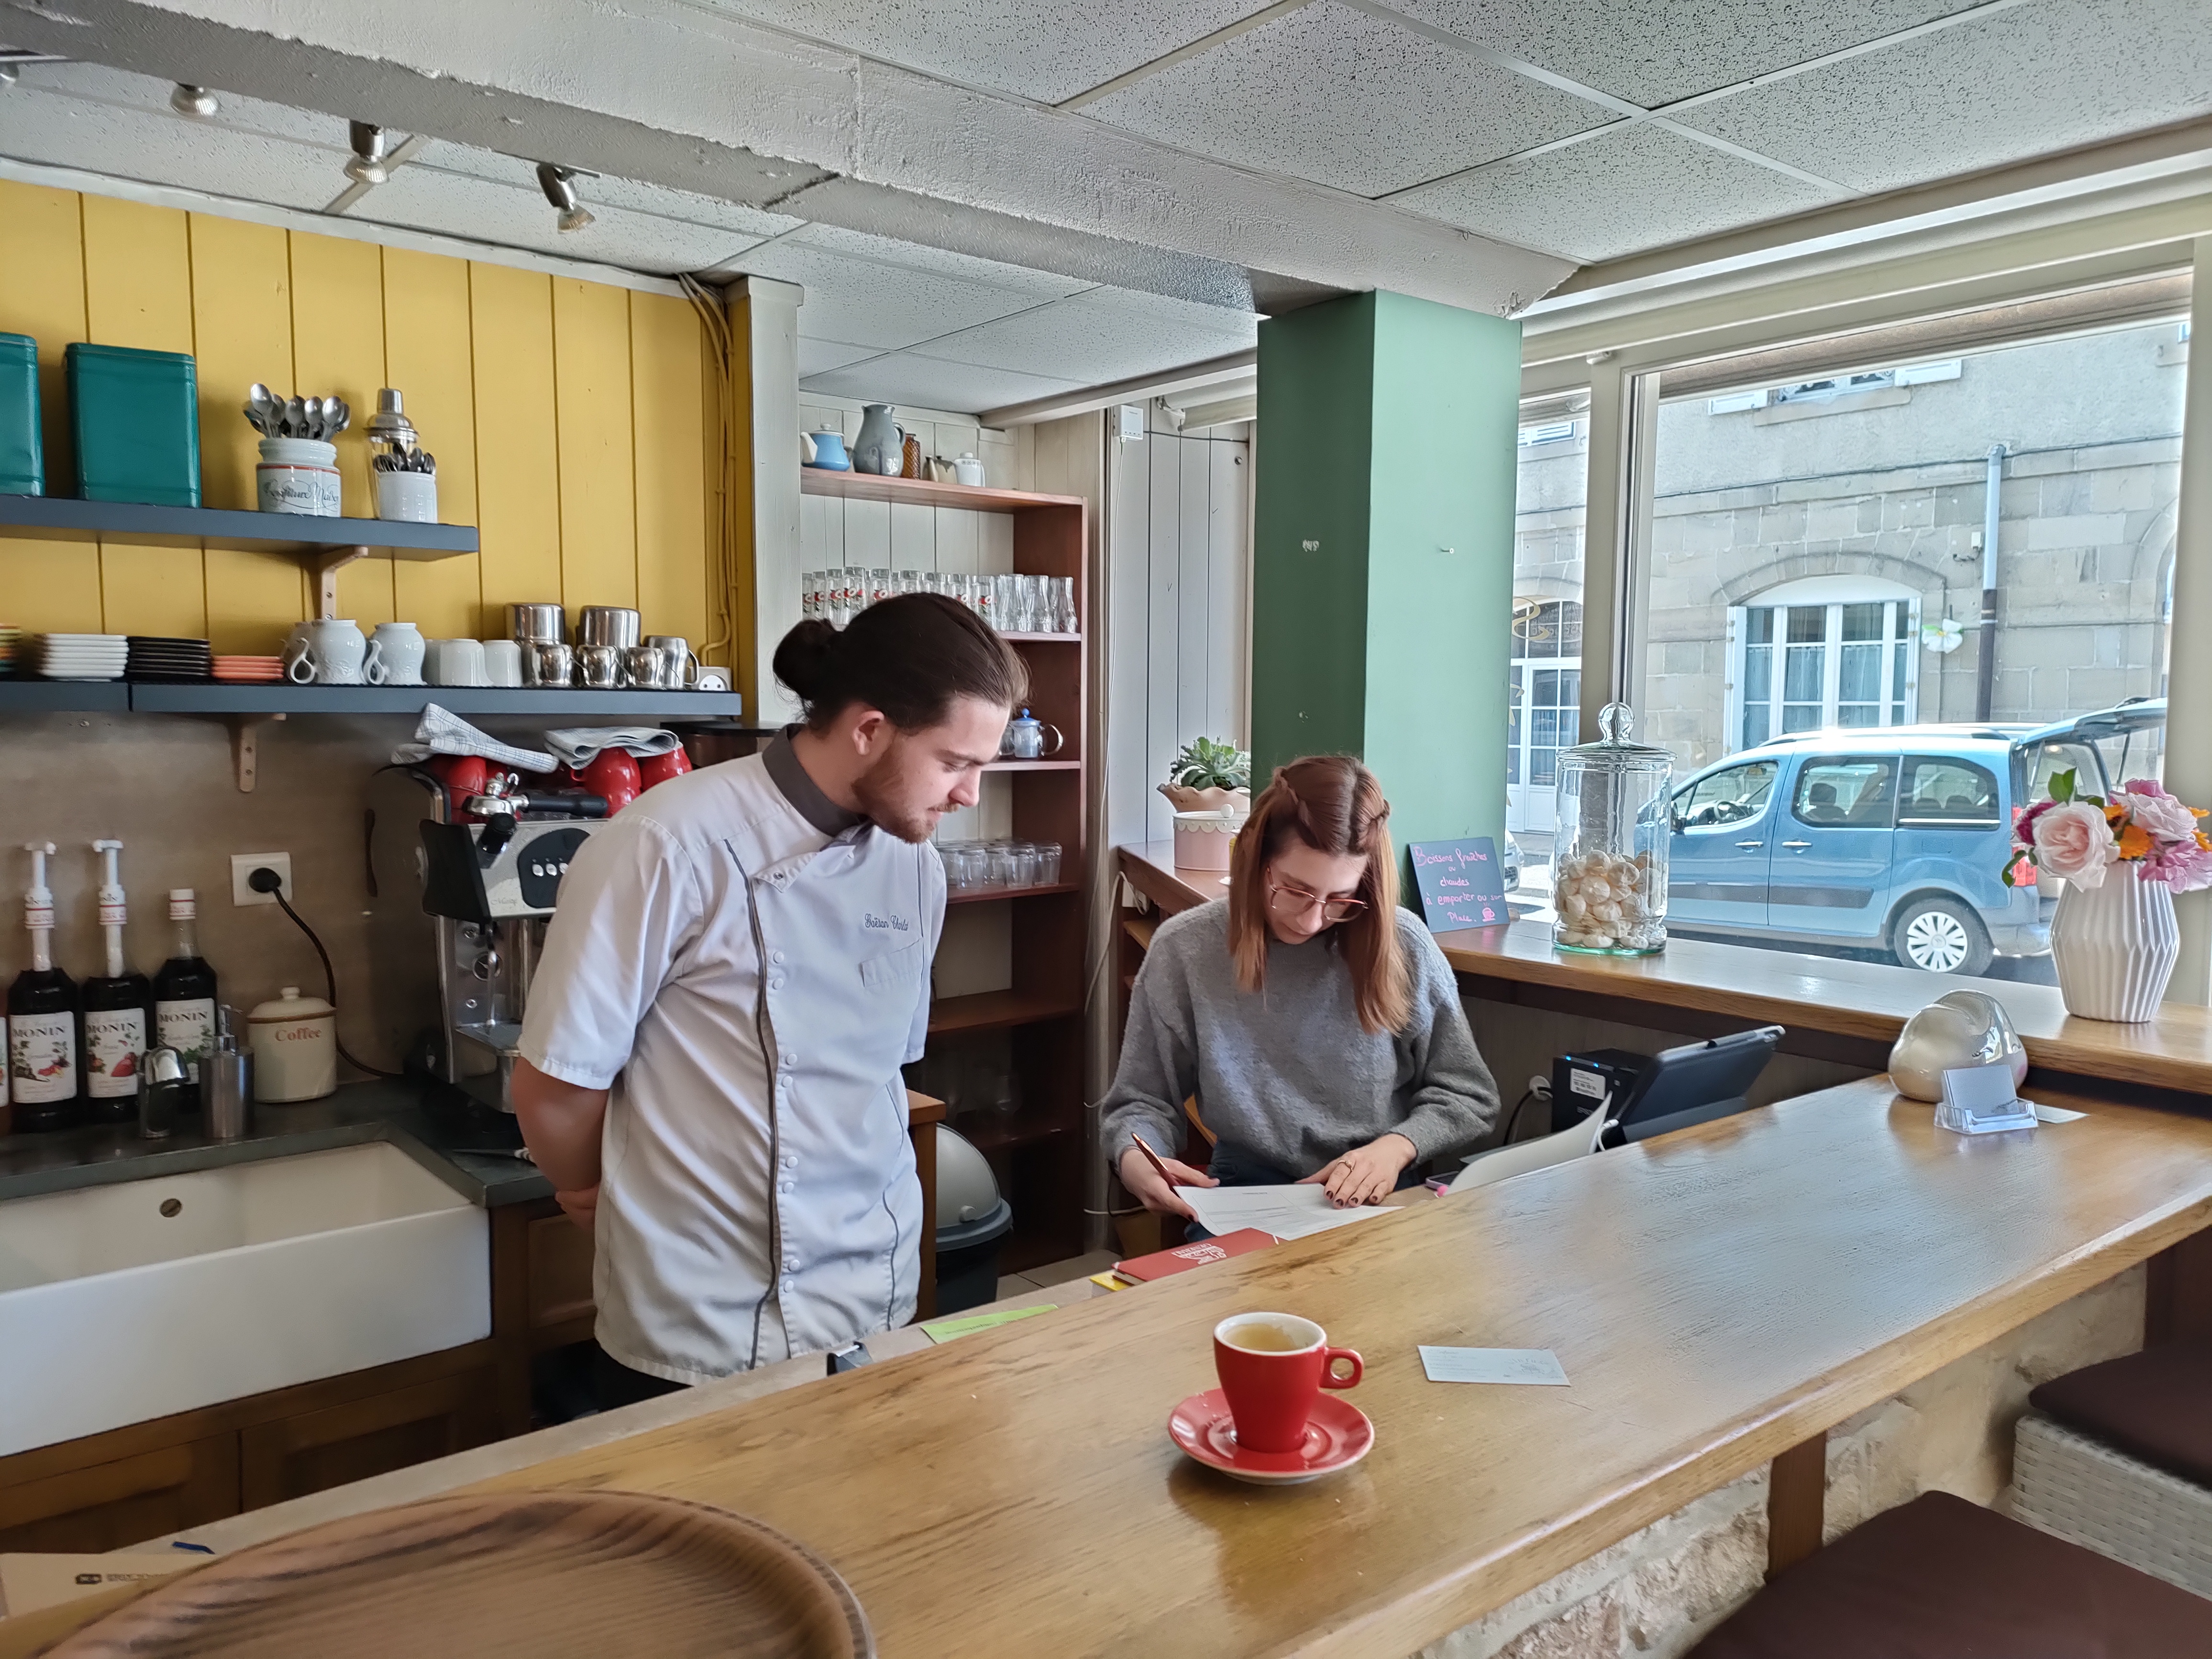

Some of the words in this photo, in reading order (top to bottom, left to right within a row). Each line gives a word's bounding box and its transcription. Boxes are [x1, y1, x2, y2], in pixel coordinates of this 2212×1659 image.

[1440, 876, 1470, 887] chaudes
[1426, 892, 1433, 906] à
[1438, 891, 1475, 906] emporter
[156, 1010, 208, 1022] MONIN
[12, 1025, 67, 1038] MONIN
[86, 1022, 138, 1033] MONIN
[275, 1027, 321, 1041] Coffee
